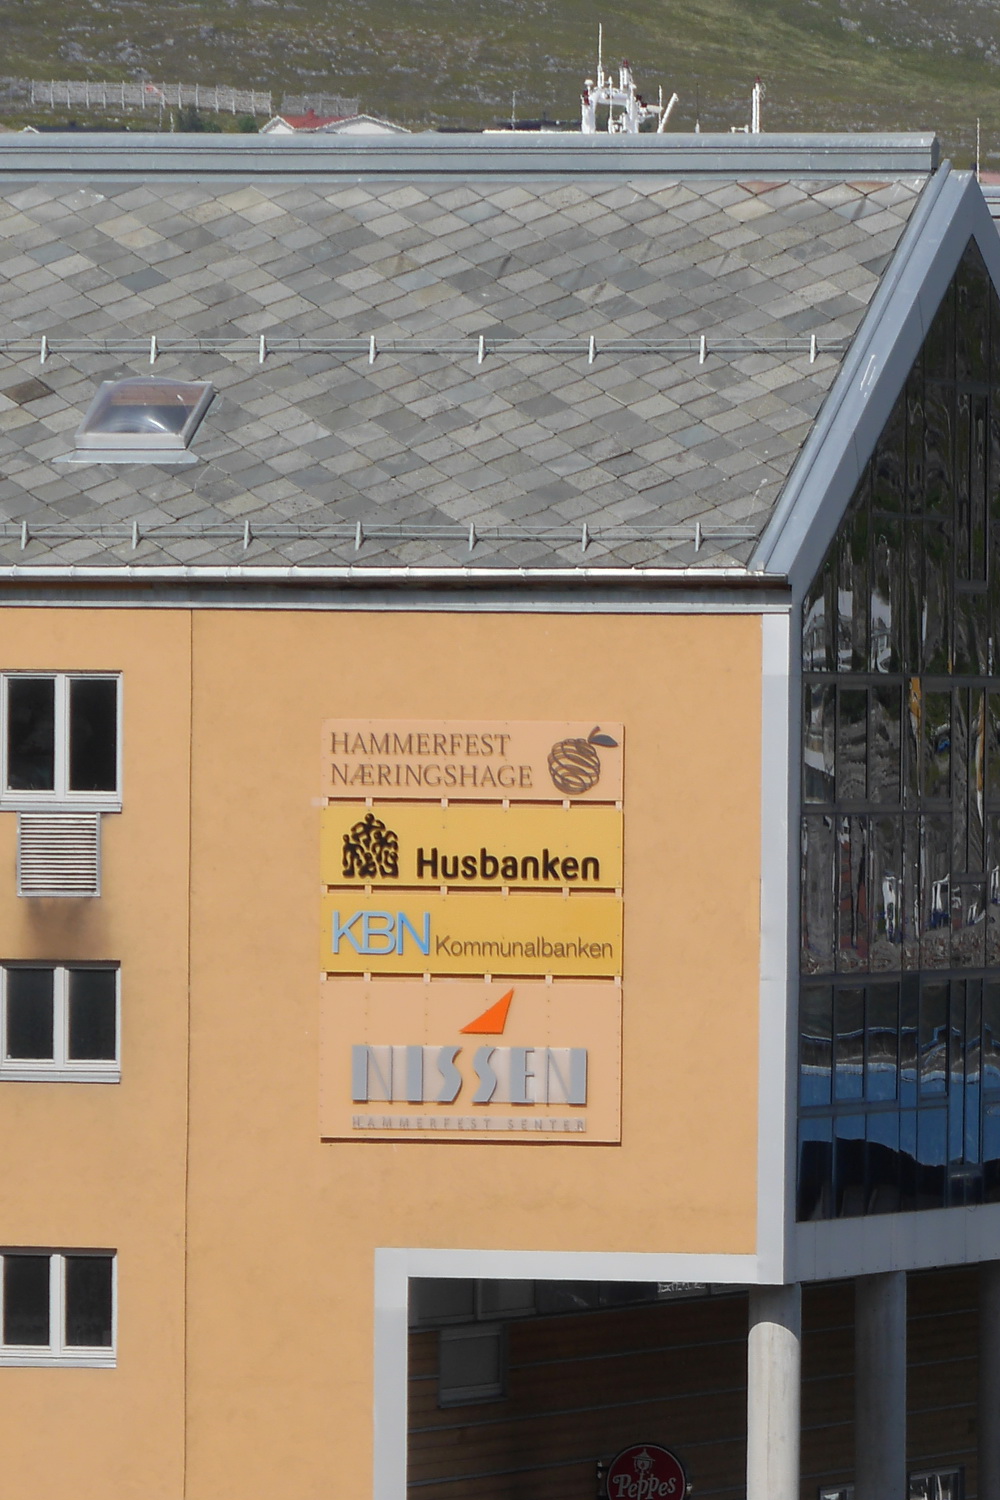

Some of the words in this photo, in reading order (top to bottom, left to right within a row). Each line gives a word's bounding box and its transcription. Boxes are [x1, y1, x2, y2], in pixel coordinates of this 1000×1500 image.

[330, 731, 511, 757] HAMMERFEST
[330, 763, 533, 789] NÆRINGSHAGE
[416, 847, 600, 881] Husbanken
[331, 910, 430, 956] KBN
[435, 934, 613, 959] Kommunalbanken
[352, 1044, 587, 1105] NISSEN
[352, 1114, 490, 1131] HAMMERFEST
[507, 1117, 585, 1132] SENTER
[612, 1473, 677, 1500] Peppes
